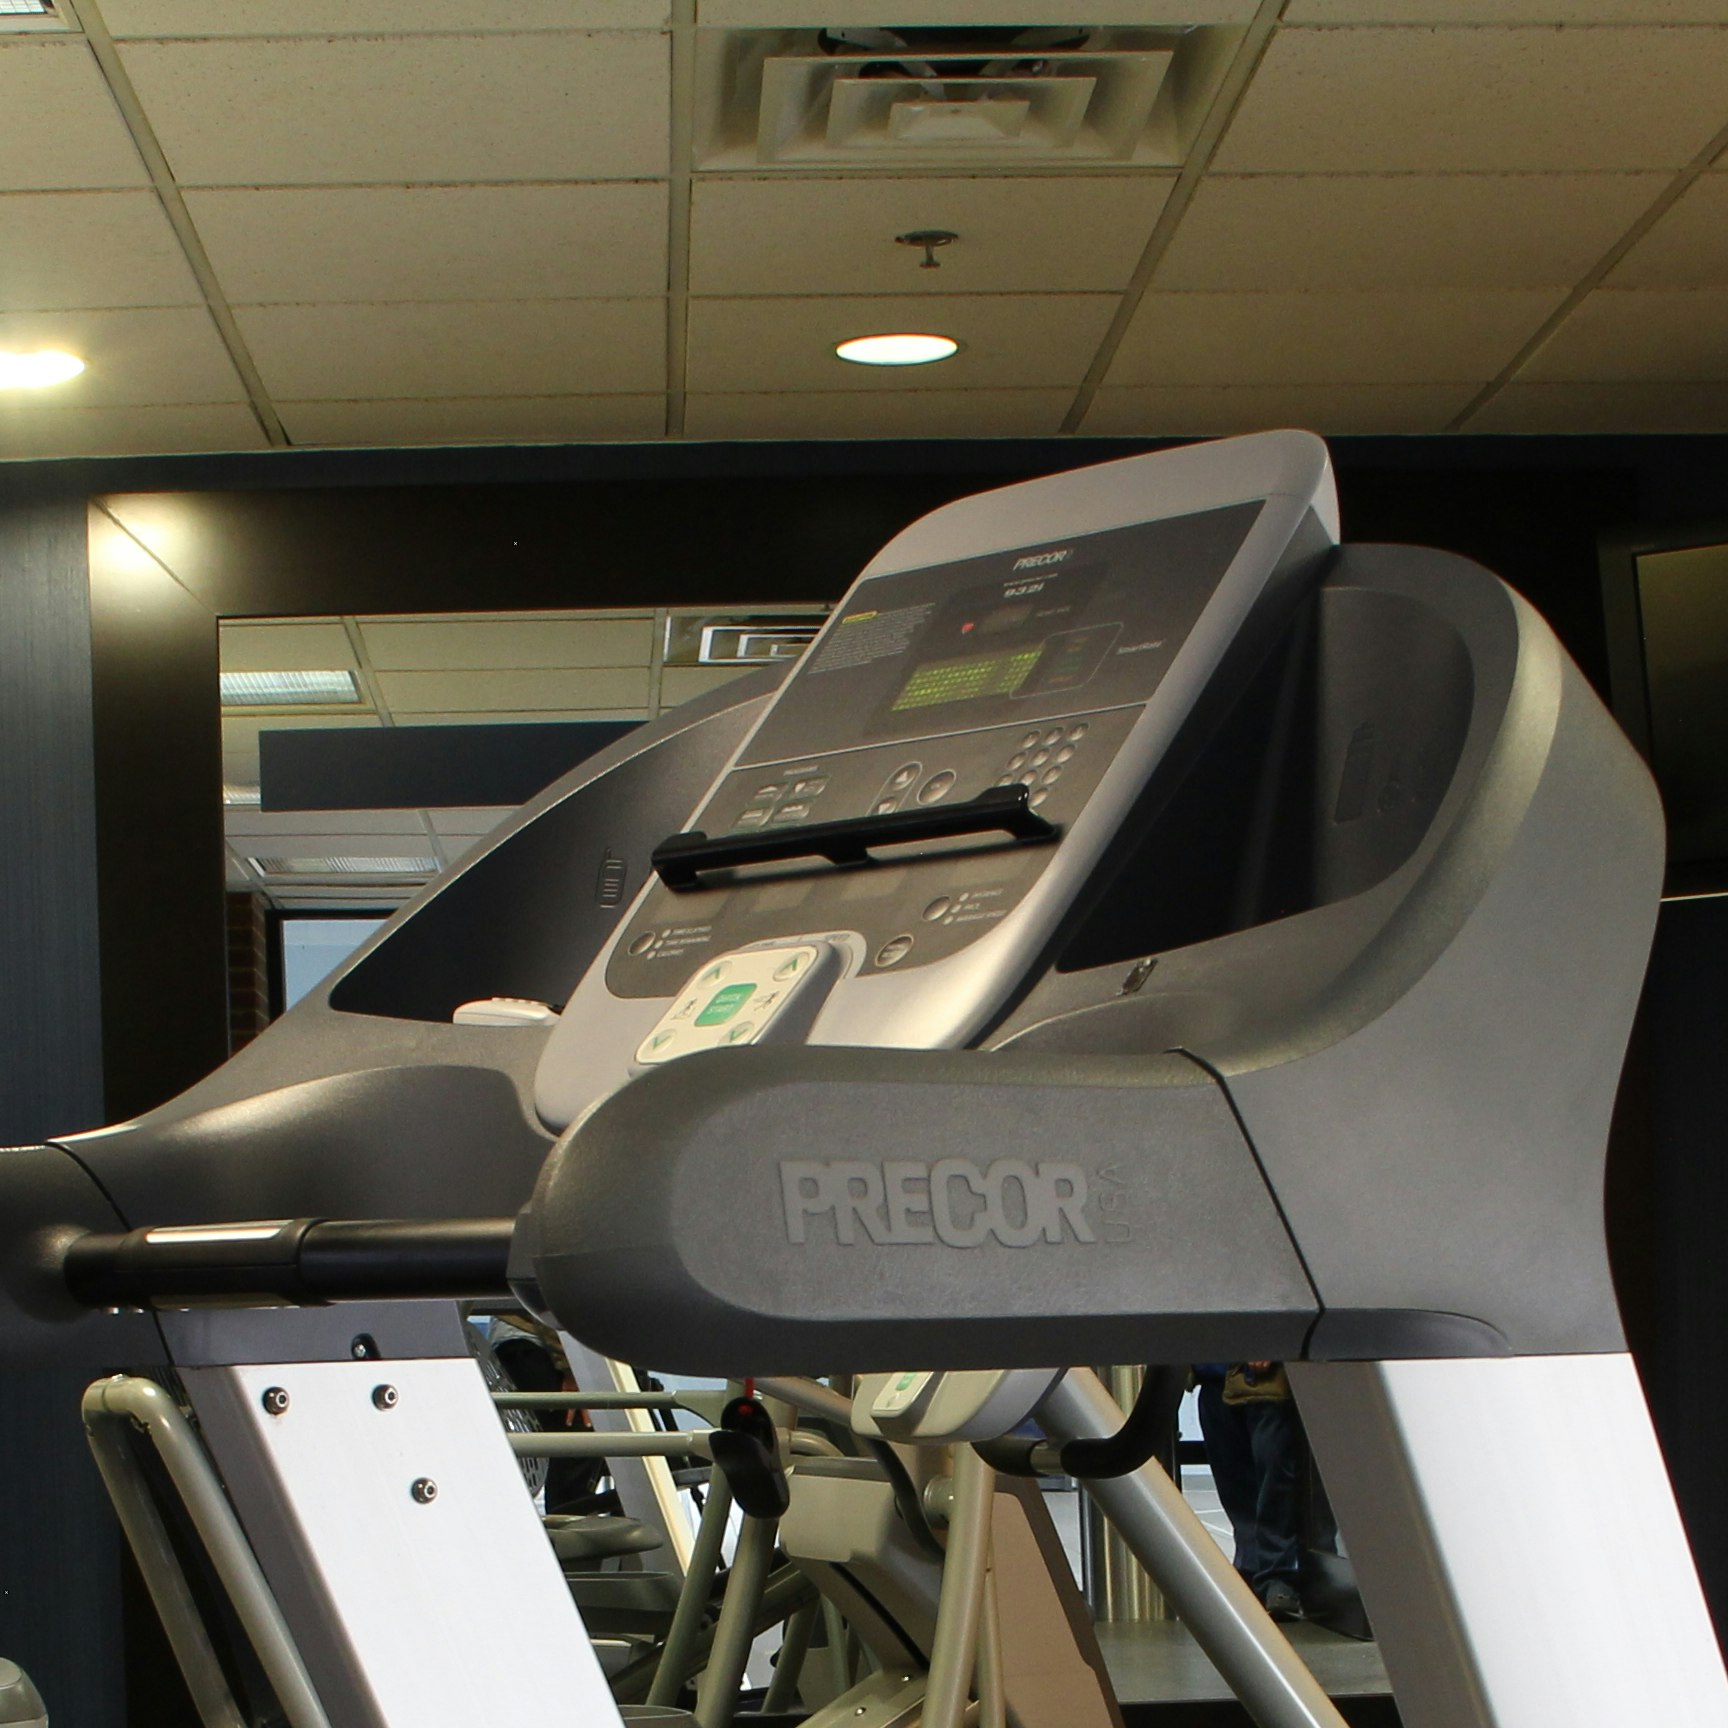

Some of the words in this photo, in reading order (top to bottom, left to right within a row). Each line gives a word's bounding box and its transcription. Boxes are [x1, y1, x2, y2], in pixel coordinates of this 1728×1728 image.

[1013, 550, 1068, 571] PRECOR
[778, 1157, 1097, 1249] PRECOR
[1095, 1164, 1133, 1243] USA
